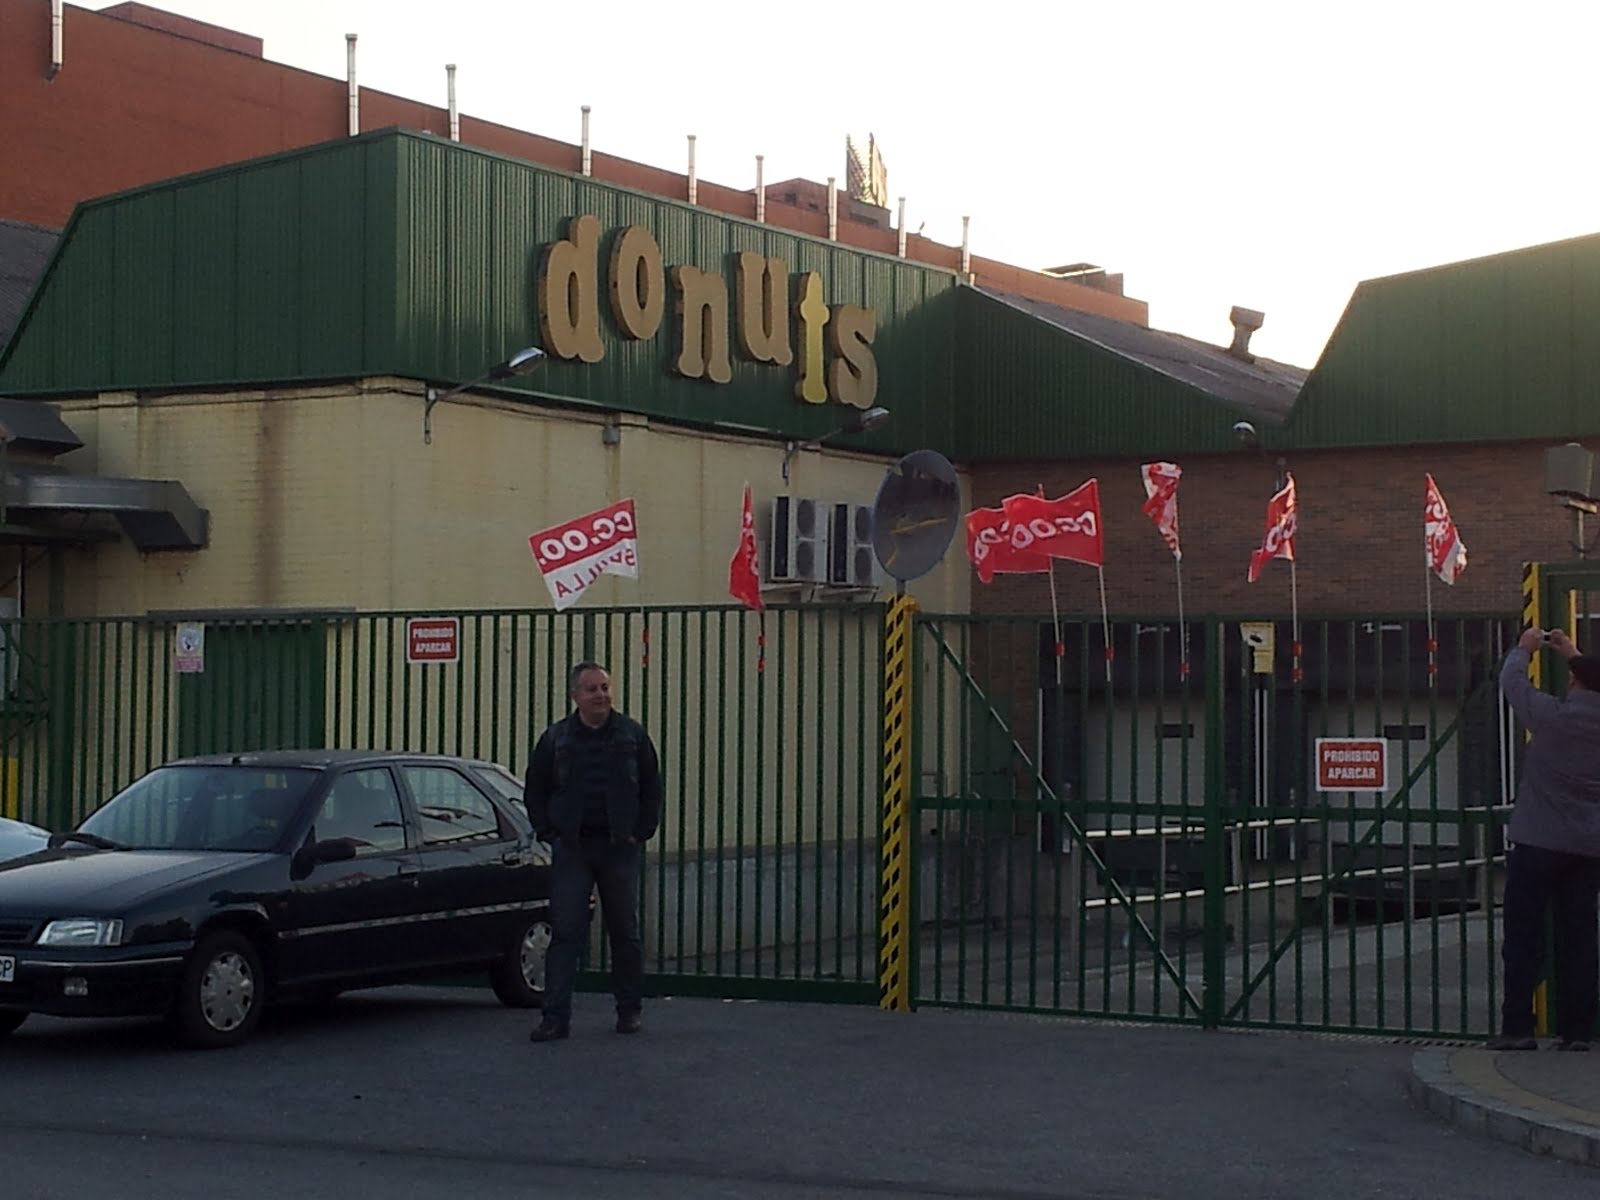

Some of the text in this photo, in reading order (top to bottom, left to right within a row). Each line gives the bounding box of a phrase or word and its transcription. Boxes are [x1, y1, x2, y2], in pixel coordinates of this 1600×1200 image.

[539, 214, 878, 410] donuts
[1323, 750, 1380, 763] PROHIBIDO
[1327, 767, 1377, 780] APARCAR
